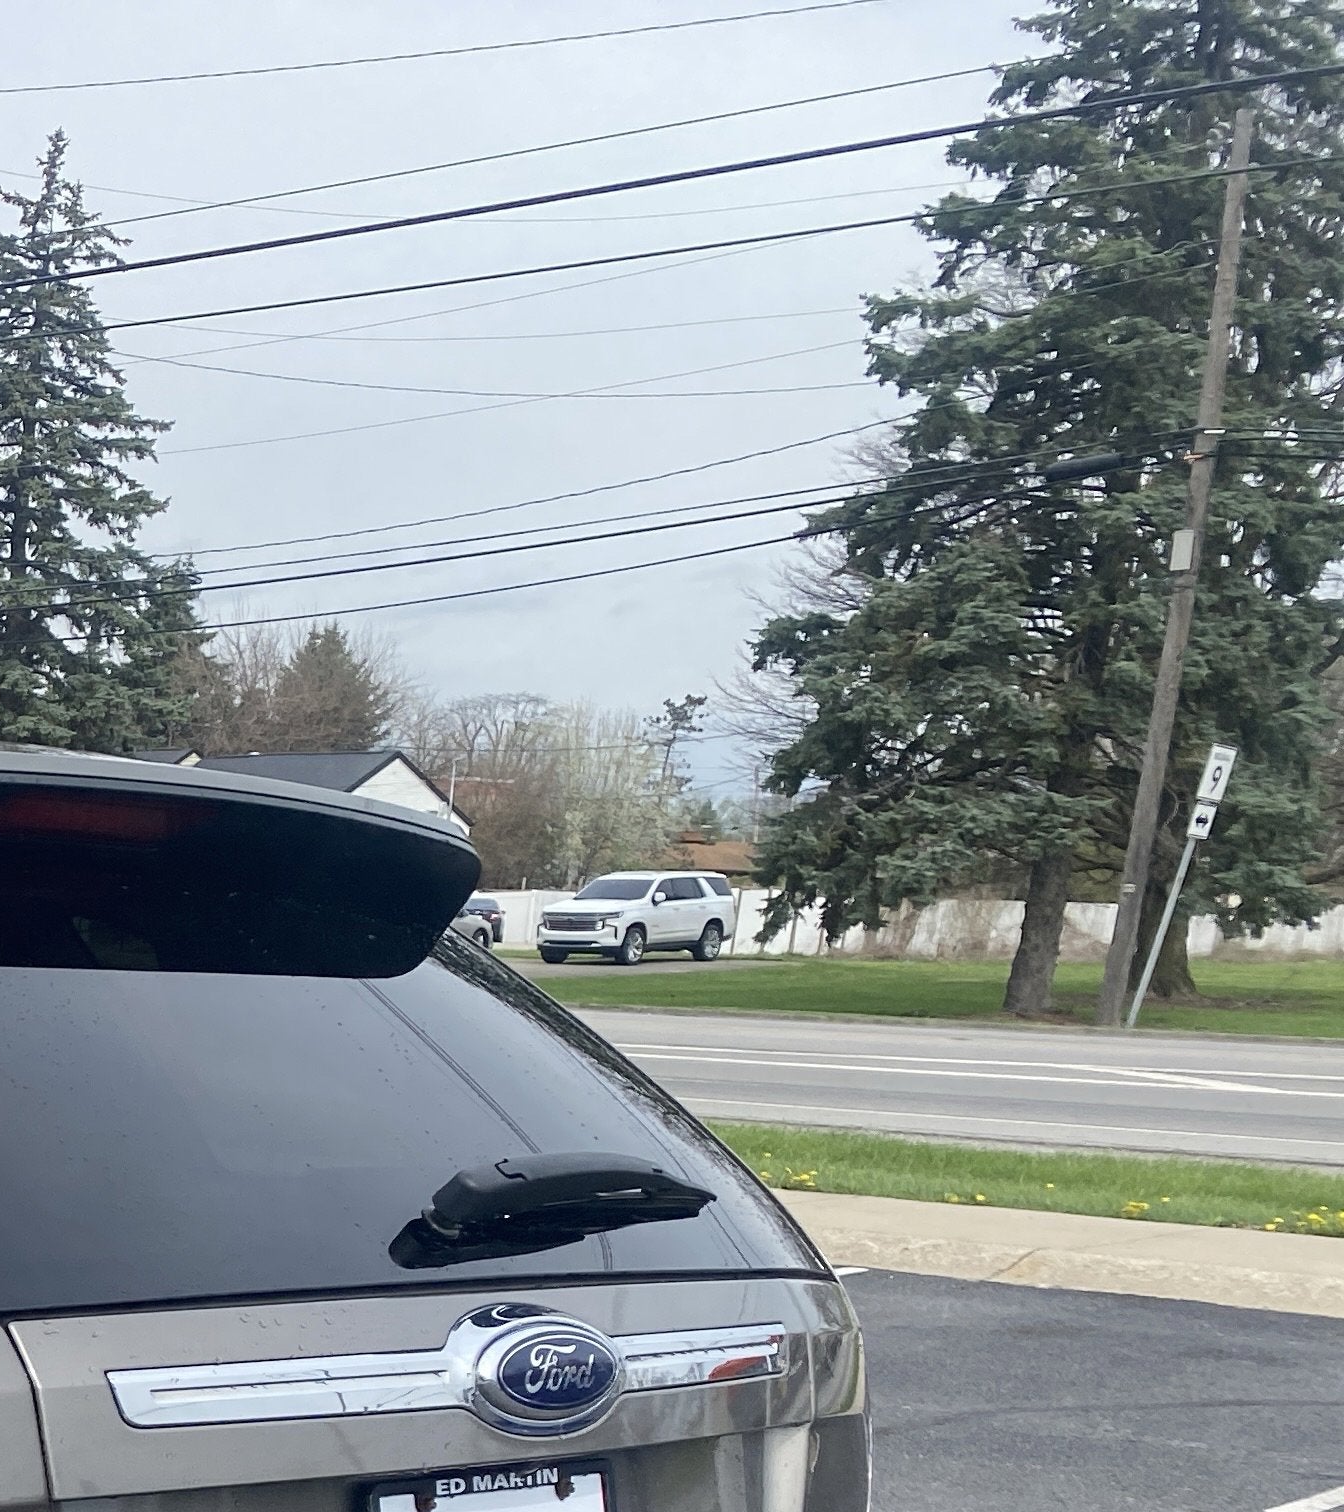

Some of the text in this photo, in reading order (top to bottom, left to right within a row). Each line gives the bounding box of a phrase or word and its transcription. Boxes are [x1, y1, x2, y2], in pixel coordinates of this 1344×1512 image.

[1210, 765, 1223, 794] 9
[524, 1343, 595, 1394] Ford
[435, 1477, 467, 1496] ED
